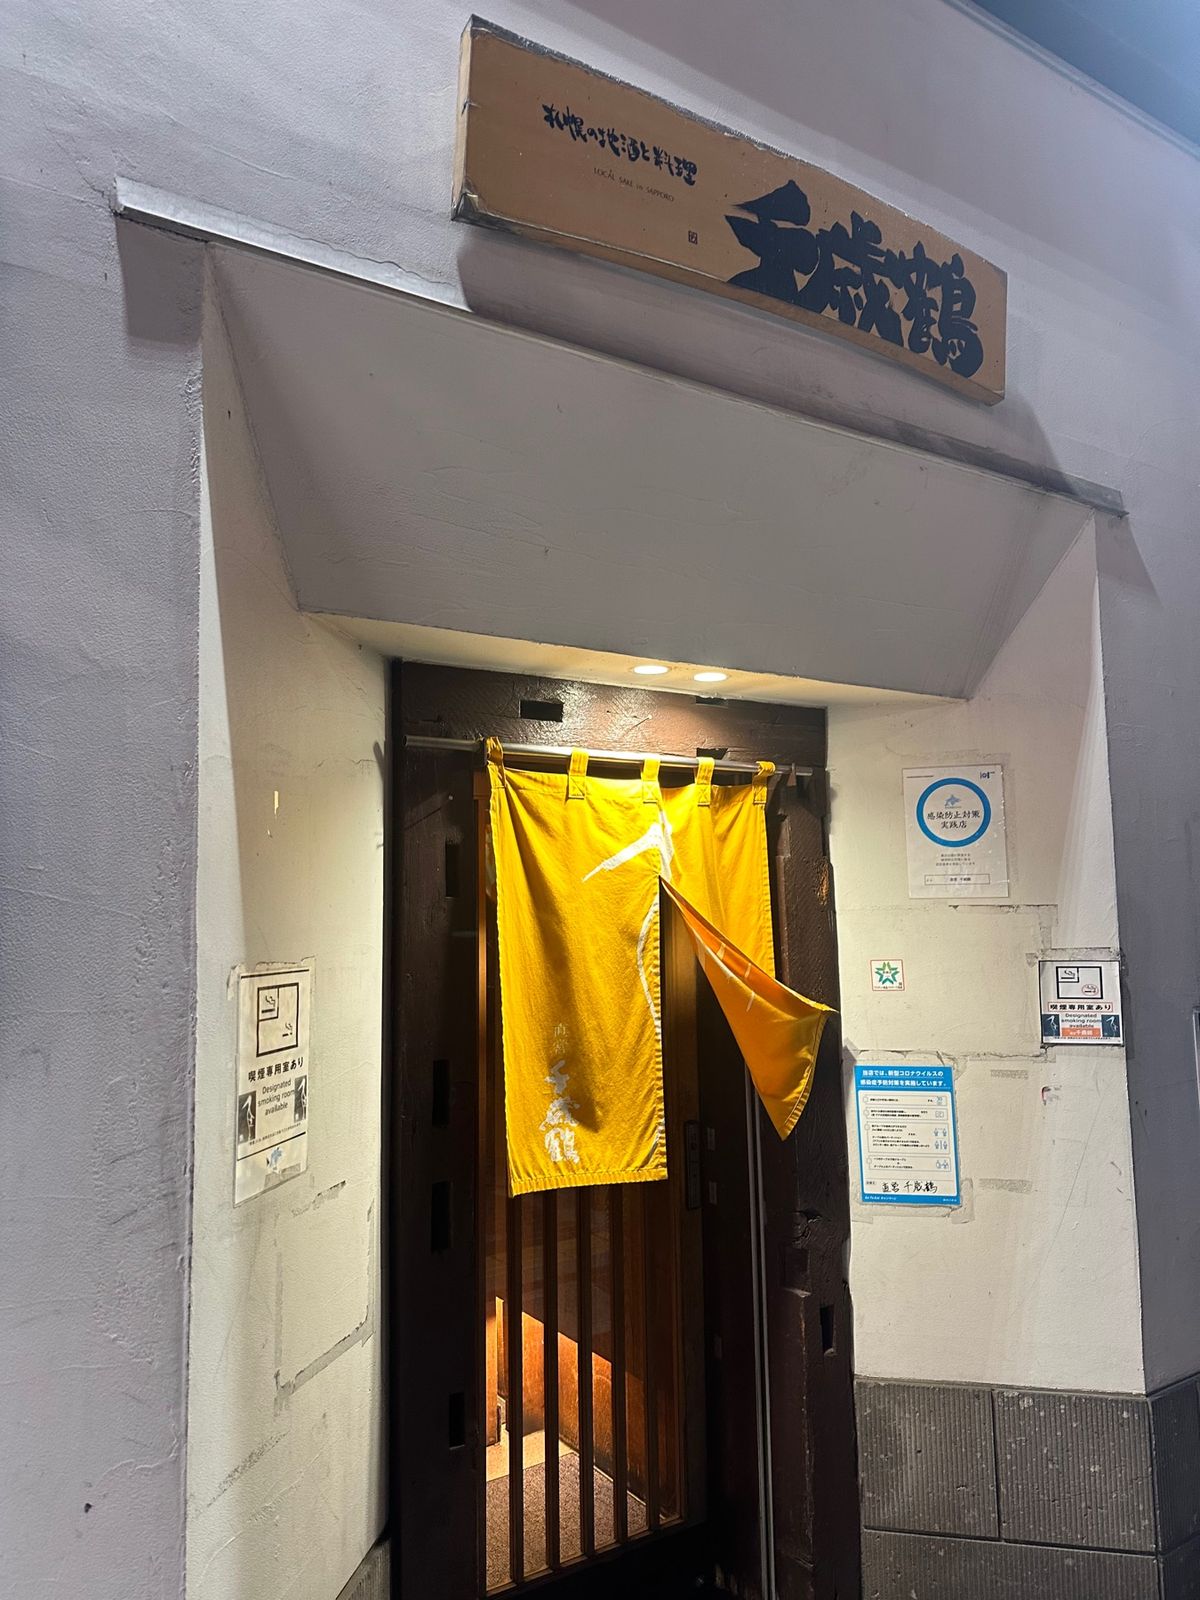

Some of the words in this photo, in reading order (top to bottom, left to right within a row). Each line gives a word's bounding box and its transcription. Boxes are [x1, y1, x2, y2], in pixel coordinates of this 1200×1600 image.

[542, 103, 698, 186] 札幌の地酒と料理
[645, 186, 675, 202] SAPPORO
[724, 179, 984, 379] 千歳鶴
[927, 810, 981, 820] 感染防止対策
[941, 820, 967, 829] 実践店
[248, 1057, 303, 1082] 喫煙専用室あり
[262, 1080, 291, 1094] Designated
[258, 1094, 280, 1107] smoking
[281, 1090, 295, 1098] room
[265, 1102, 288, 1115] available
